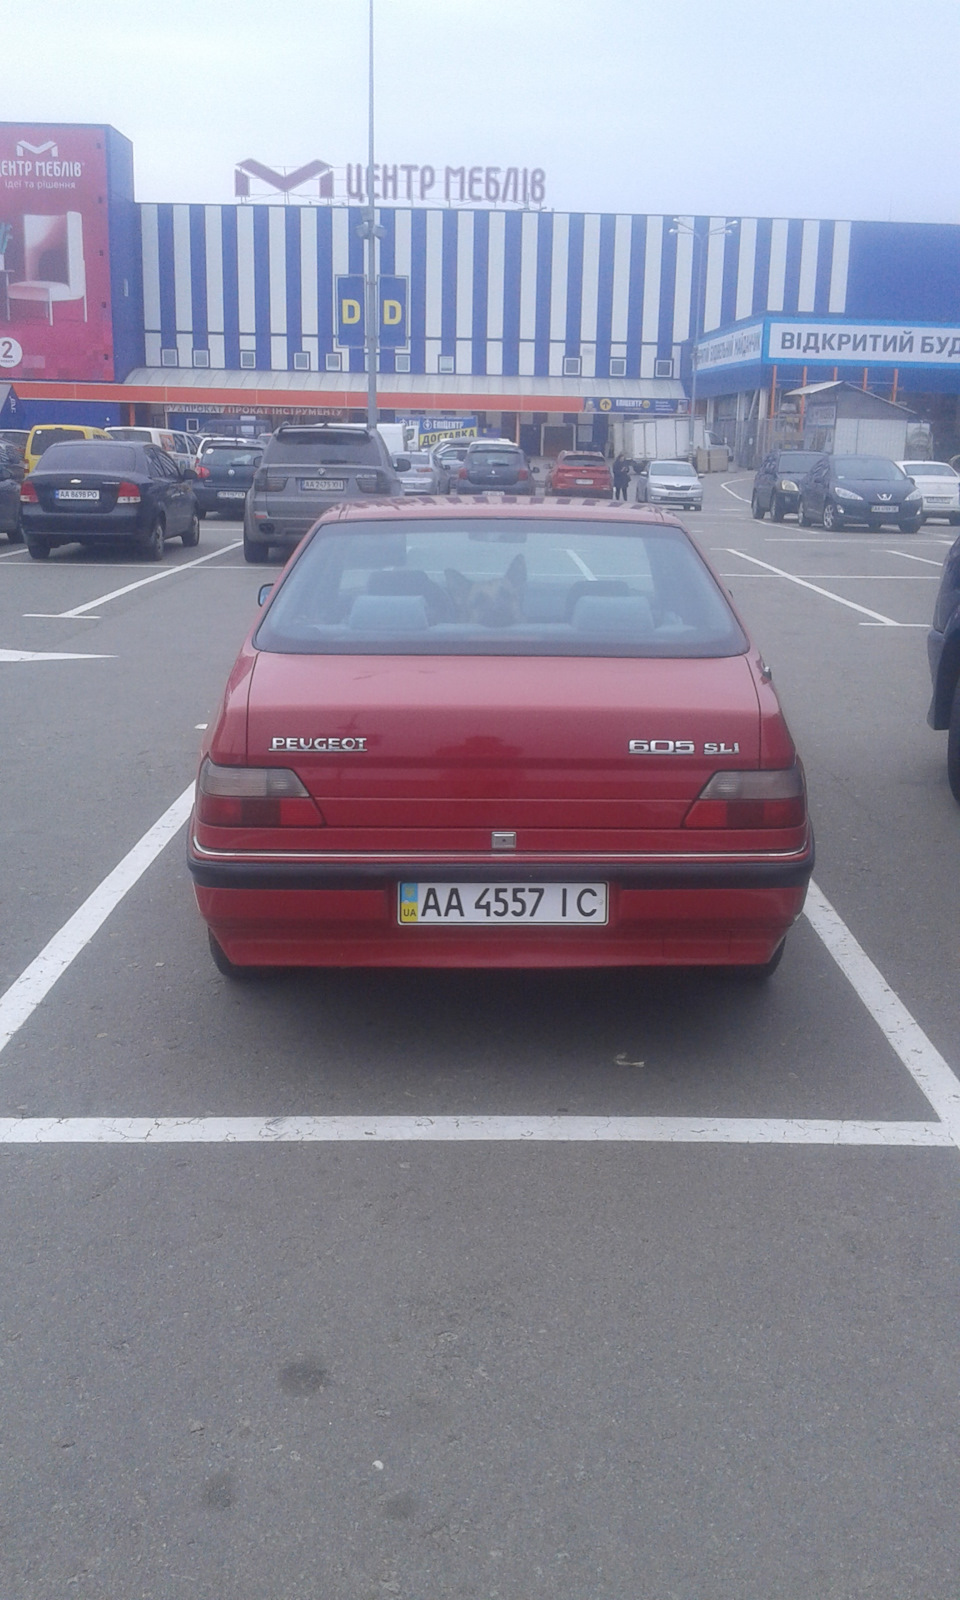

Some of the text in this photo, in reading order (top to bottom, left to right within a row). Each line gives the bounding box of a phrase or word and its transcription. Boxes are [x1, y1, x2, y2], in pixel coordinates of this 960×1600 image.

[0, 160, 82, 177] ЕНТР МЕБЛІВ
[346, 163, 546, 203] ЦЕНТР МЕБЛІВ
[342, 299, 361, 324] D
[383, 299, 402, 325] D
[2, 340, 13, 359] 2
[780, 330, 914, 353] ВІДКРИТИЙ
[422, 429, 475, 446] ДОСТАВКА
[271, 737, 368, 751] PEUGEOT
[628, 740, 695, 754] 605
[421, 887, 598, 917] AA 4557 IC
[403, 908, 417, 917] UA
